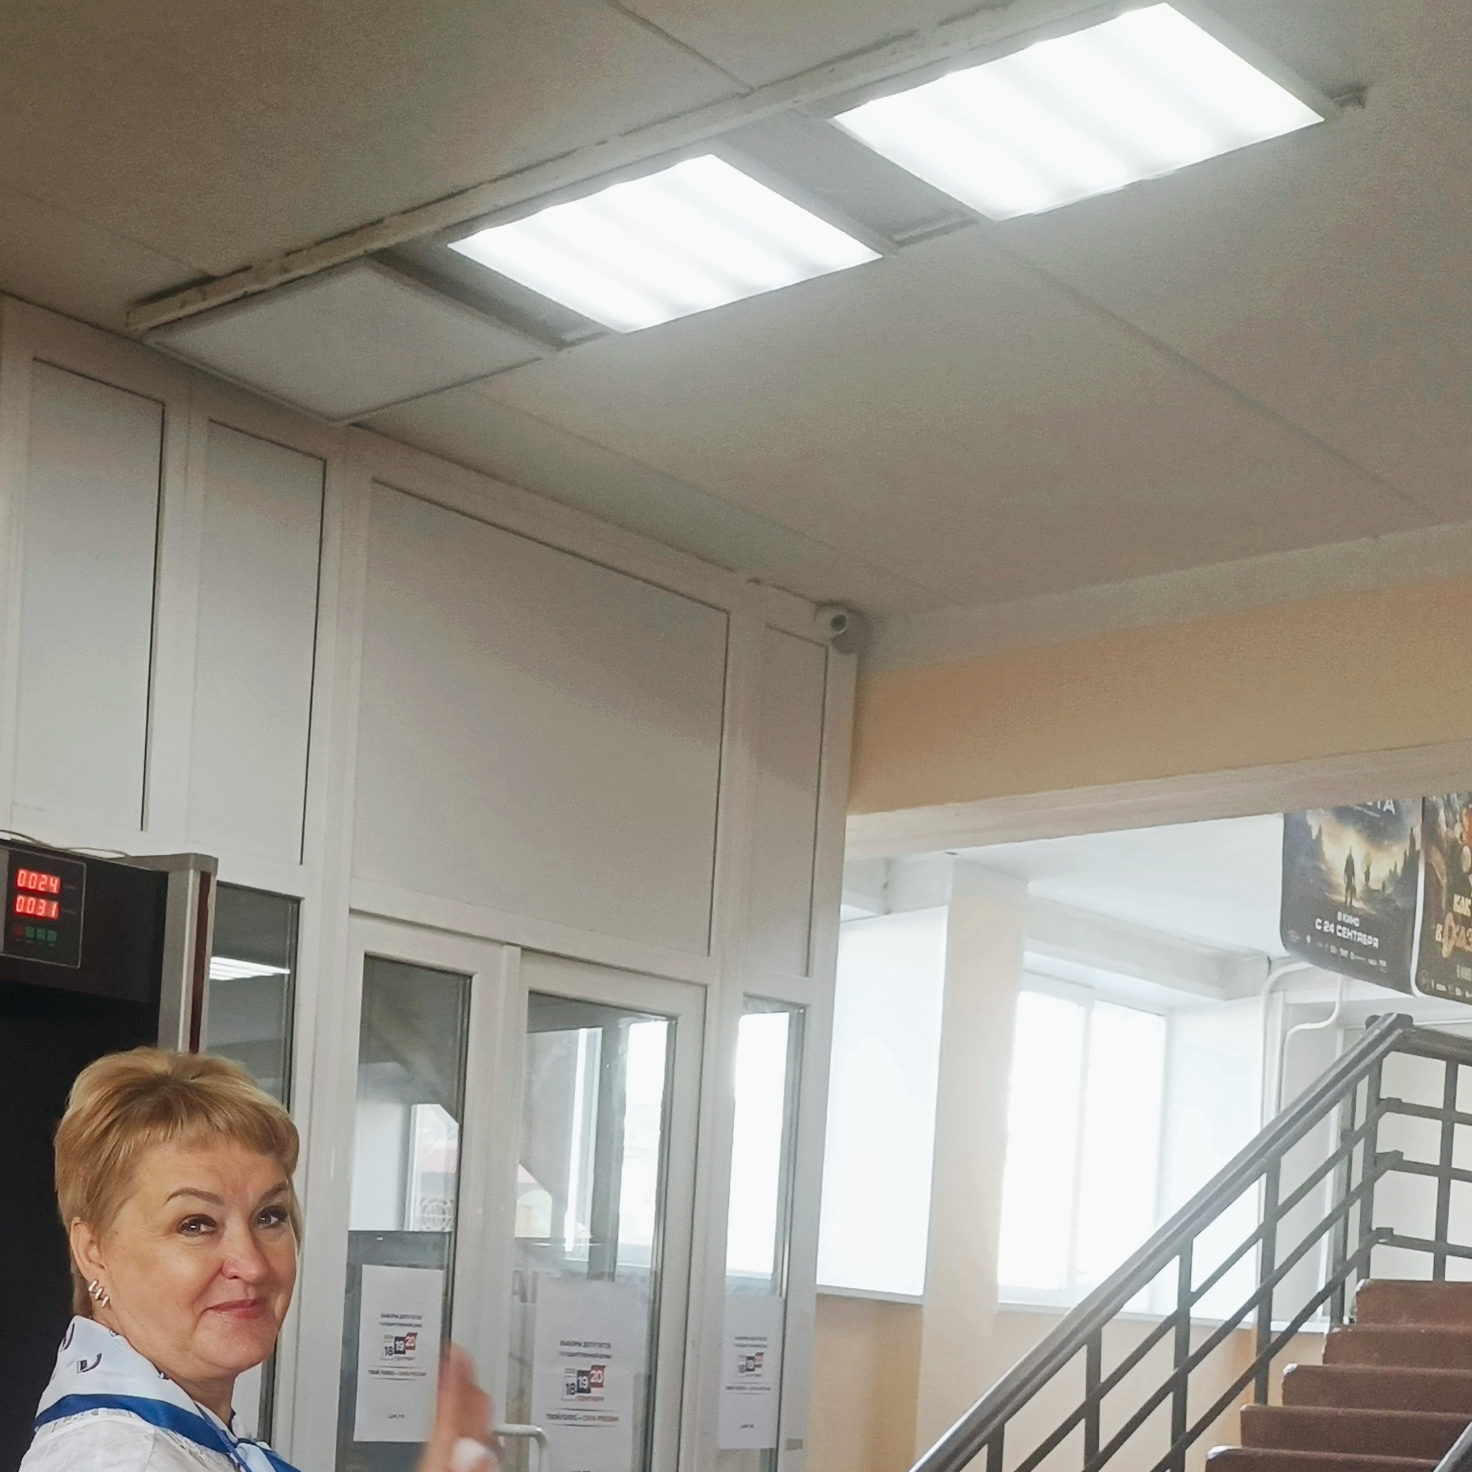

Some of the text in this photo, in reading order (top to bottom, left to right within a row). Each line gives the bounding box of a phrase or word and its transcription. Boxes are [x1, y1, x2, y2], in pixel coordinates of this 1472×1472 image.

[17, 869, 61, 894] 0024
[16, 895, 59, 919] 0031
[1336, 924, 1379, 948] СЕНТЯБРЯ
[384, 1346, 394, 1356] 18
[395, 1341, 404, 1351] 19
[565, 1370, 602, 1395] 18 19 20
